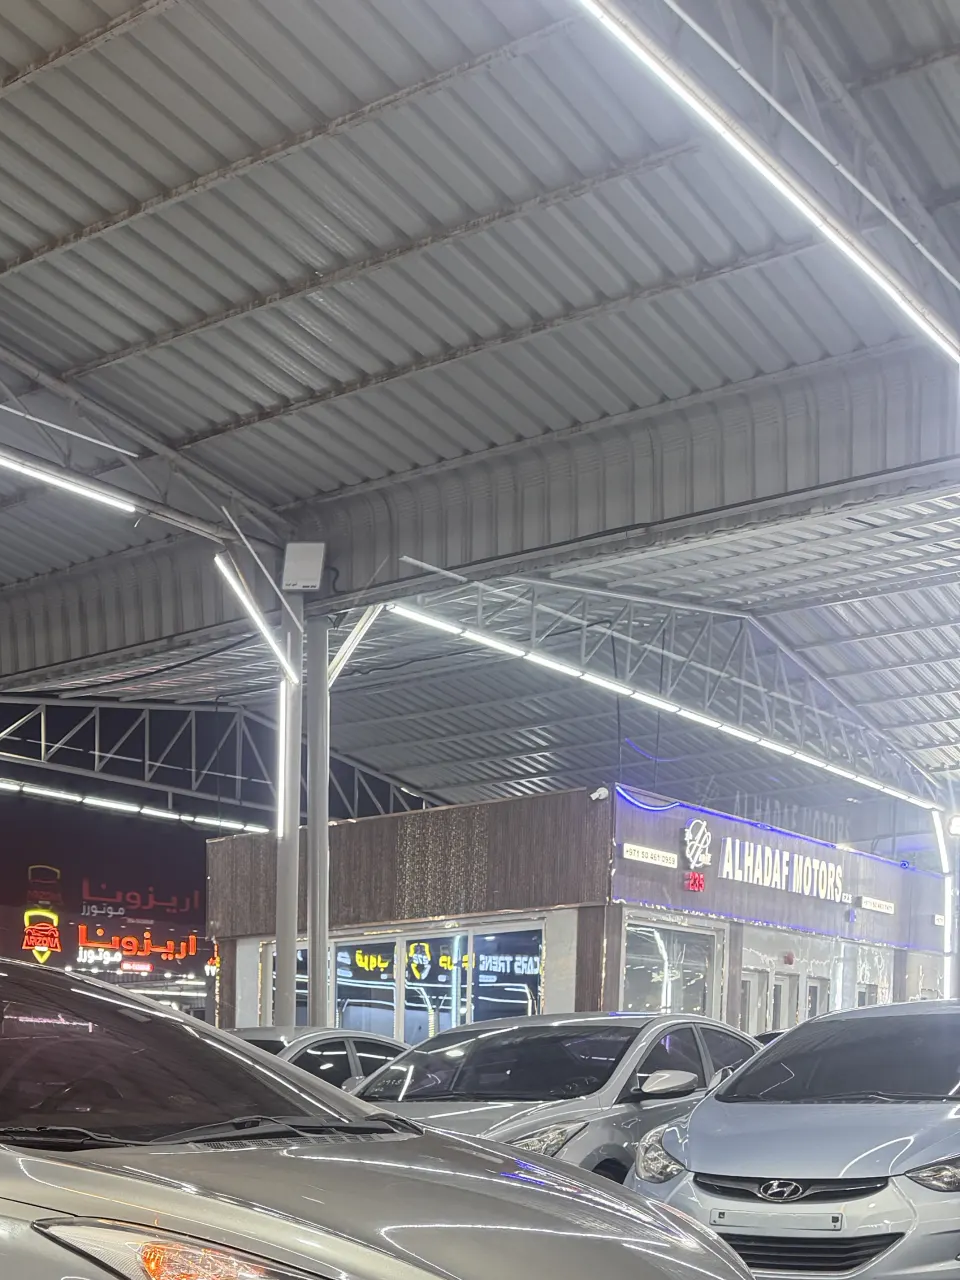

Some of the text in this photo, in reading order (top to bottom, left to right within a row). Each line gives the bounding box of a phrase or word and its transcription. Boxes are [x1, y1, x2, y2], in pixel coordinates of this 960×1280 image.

[721, 836, 790, 891] ALHADAF
[792, 853, 843, 903] MOTORS
[77, 946, 122, 965] موتورز
[78, 924, 197, 961] اريزونا
